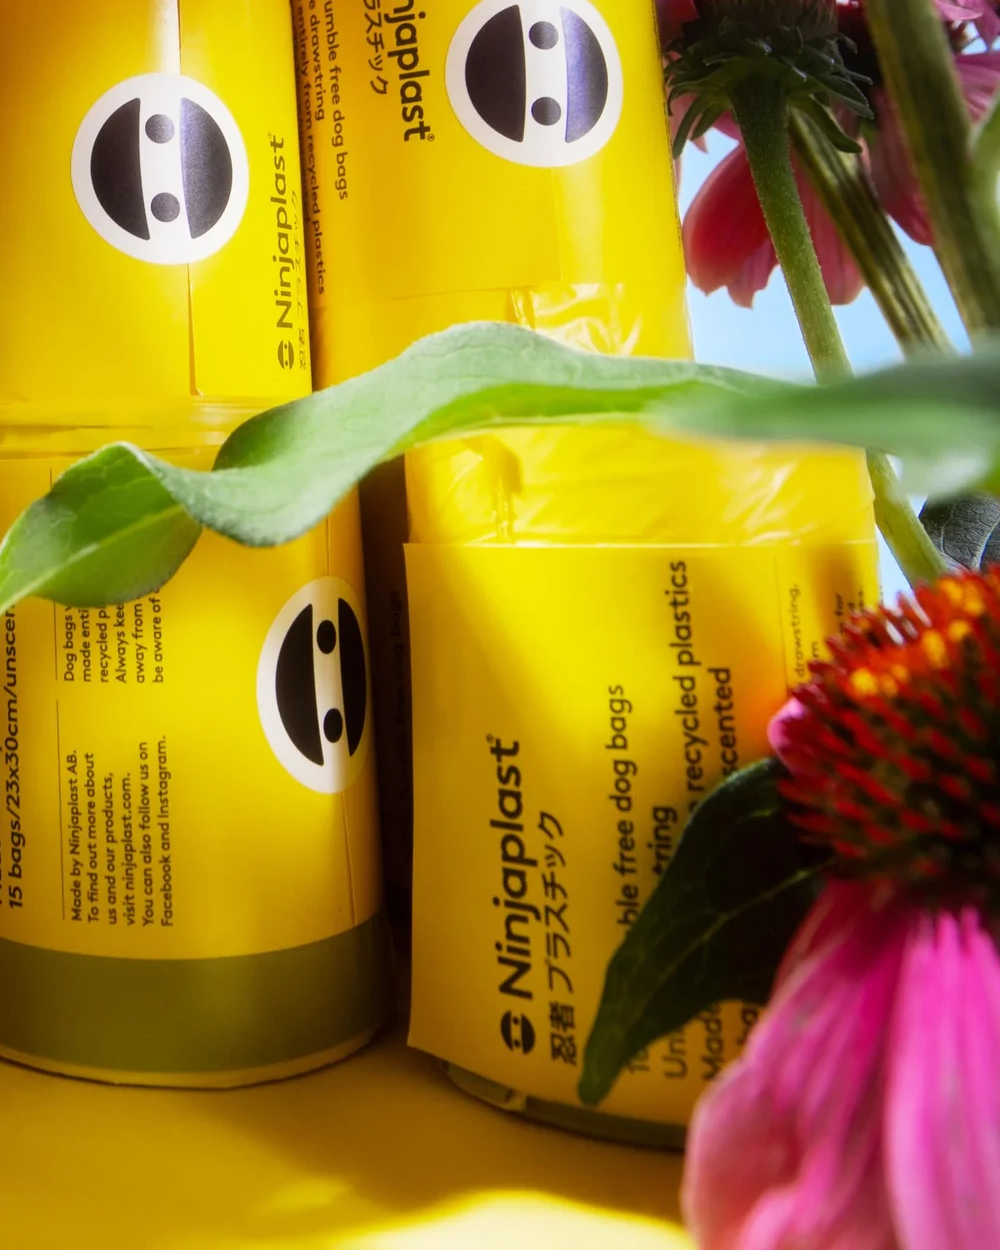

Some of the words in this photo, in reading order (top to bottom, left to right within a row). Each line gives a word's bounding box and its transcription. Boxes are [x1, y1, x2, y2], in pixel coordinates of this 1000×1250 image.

[297, 7, 309, 77] entirely
[312, 13, 327, 121] drawstring
[328, 65, 342, 105] free
[303, 81, 313, 129] from
[331, 109, 346, 147] dog
[306, 134, 320, 214] recycled
[334, 151, 349, 201] bags
[312, 220, 326, 294] plastics
[113, 603, 125, 628] kee
[132, 604, 144, 639] from
[149, 597, 161, 613] of
[663, 561, 703, 667] plastics
[63, 615, 76, 650] bags
[96, 623, 111, 683] recycled
[152, 618, 163, 662] aware
[63, 653, 77, 682] Dog
[114, 630, 128, 684] Always
[135, 643, 148, 684] away
[152, 665, 164, 683] be
[603, 685, 633, 751] bags
[671, 675, 709, 794] recycled
[66, 750, 78, 775] AB.
[138, 742, 149, 760] on
[138, 763, 149, 781] us
[155, 736, 172, 819] Instagram.
[606, 758, 638, 814] dog
[66, 778, 83, 856] Ninjaplast
[137, 784, 151, 832] follow
[119, 772, 138, 892] ninjaplast.com.
[139, 834, 152, 864] also
[158, 822, 172, 852] and
[611, 819, 639, 877] free
[68, 860, 83, 877] by
[142, 868, 153, 897] can
[69, 880, 83, 922] Made
[122, 895, 136, 927] visit
[141, 899, 155, 928] You
[158, 855, 174, 928] Facebook
[539, 809, 575, 994] プラスチック
